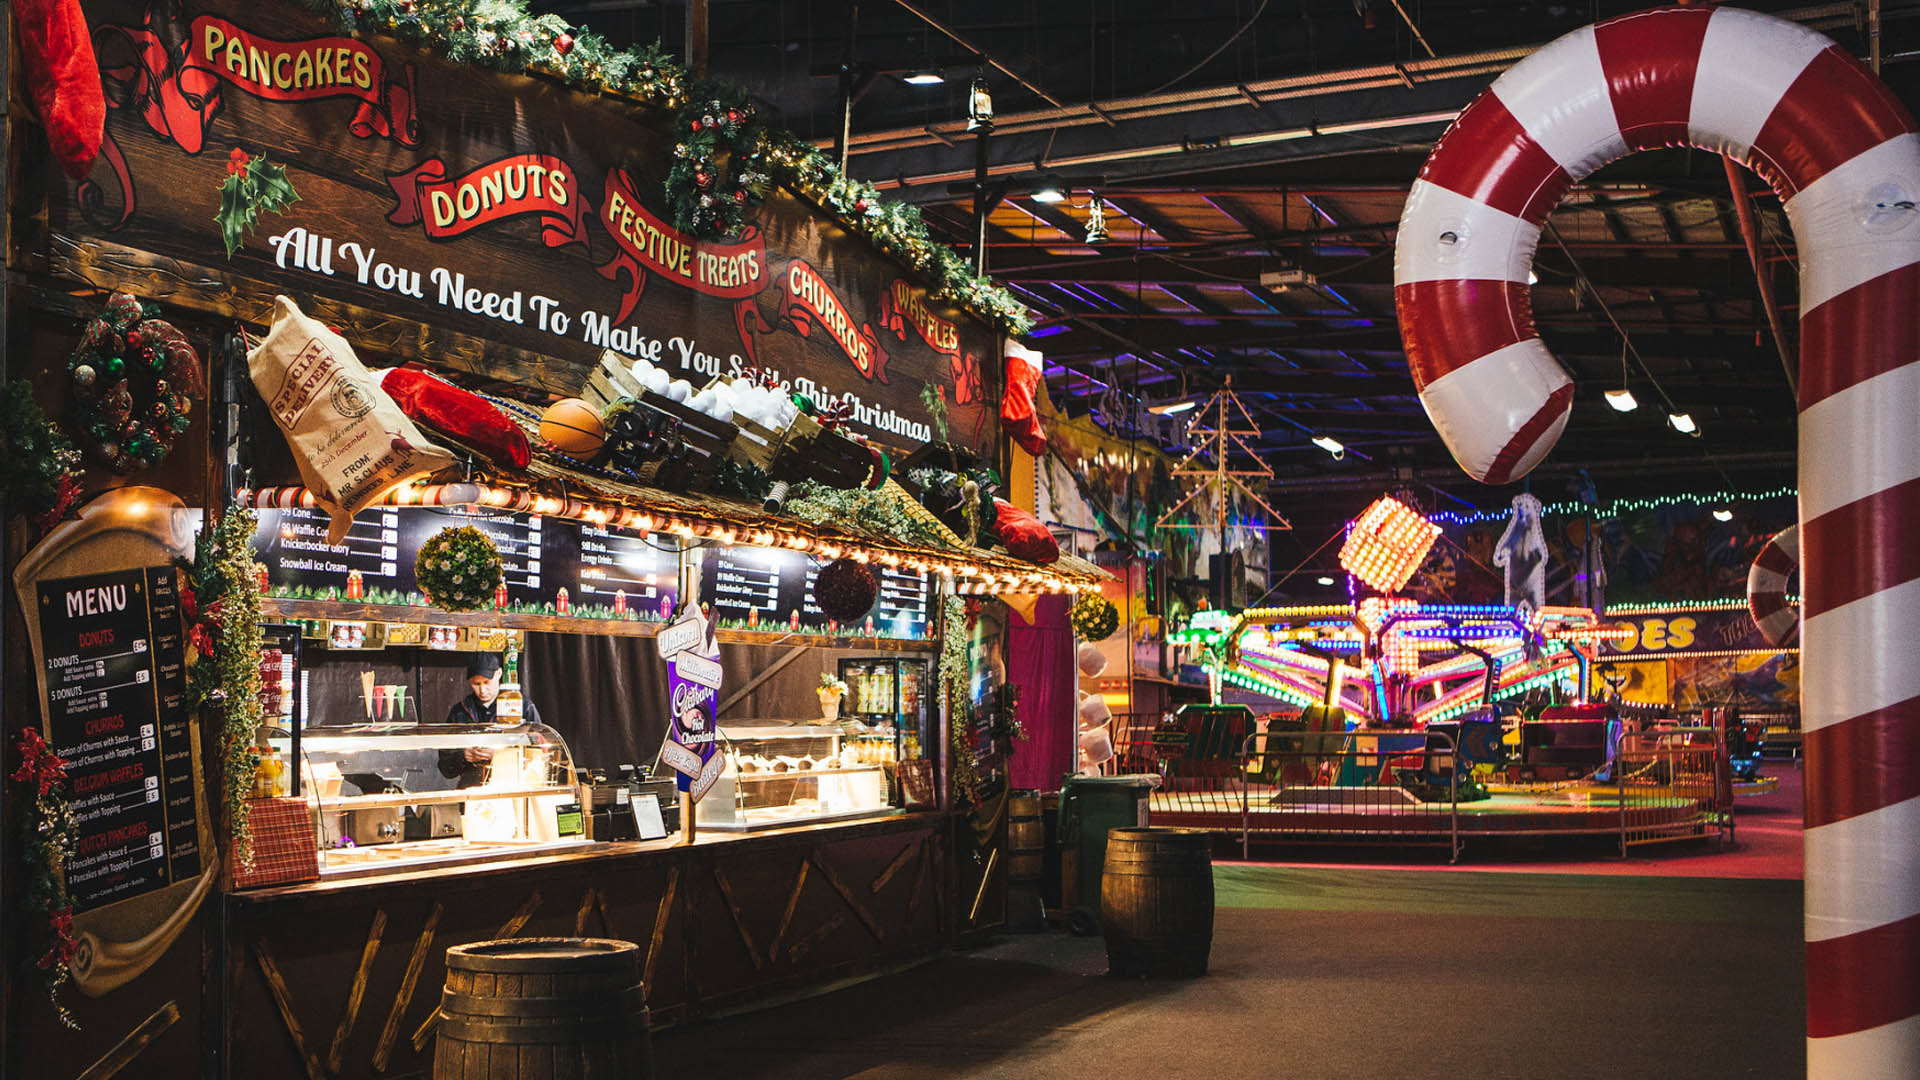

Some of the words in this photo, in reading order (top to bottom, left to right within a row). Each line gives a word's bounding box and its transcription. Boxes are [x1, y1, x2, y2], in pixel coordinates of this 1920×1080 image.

[204, 24, 372, 90] PANCAKES
[430, 164, 568, 228] DONUTS
[608, 191, 693, 277] FESTIVE
[697, 249, 760, 287] TREATS
[789, 265, 869, 371] CHURROS
[897, 283, 958, 350] WAFFLES
[268, 227, 335, 276] All
[338, 242, 424, 299] You
[430, 267, 524, 325] Need
[529, 294, 571, 336] To
[581, 310, 663, 362] Make
[667, 336, 722, 378] You
[842, 392, 932, 444] Christmas
[275, 344, 325, 414] SPECIAL
[284, 354, 337, 424] DELIVERY
[335, 430, 368, 458] December
[388, 459, 416, 479] LANE
[337, 482, 356, 497] MR
[292, 507, 311, 519] Cone
[291, 523, 315, 536] Waffle
[280, 536, 330, 553] Knickerbocker
[590, 542, 607, 553] Drinks
[279, 556, 313, 570] Snowball
[313, 559, 325, 571] Ice
[324, 562, 348, 574] Cream
[597, 555, 613, 566] Drinks
[65, 583, 127, 619] MENU
[78, 628, 115, 648] DONUTS
[660, 625, 699, 654] Unicorn
[53, 653, 80, 668] DONUTS
[56, 685, 83, 699] DONUTS
[672, 683, 715, 718] Cadbury
[84, 713, 125, 737] CHURROS
[691, 718, 705, 731] Hot
[83, 741, 103, 753] Churros
[103, 737, 115, 747] with
[114, 734, 130, 745] Sauce
[681, 731, 715, 745] Chocolate
[104, 751, 116, 761] with
[116, 746, 136, 757] Topping
[109, 762, 145, 787] WAFFLES
[87, 793, 100, 806] with
[99, 792, 116, 804] Sauce
[100, 804, 121, 816] Topping
[107, 819, 149, 847] PANCAKES
